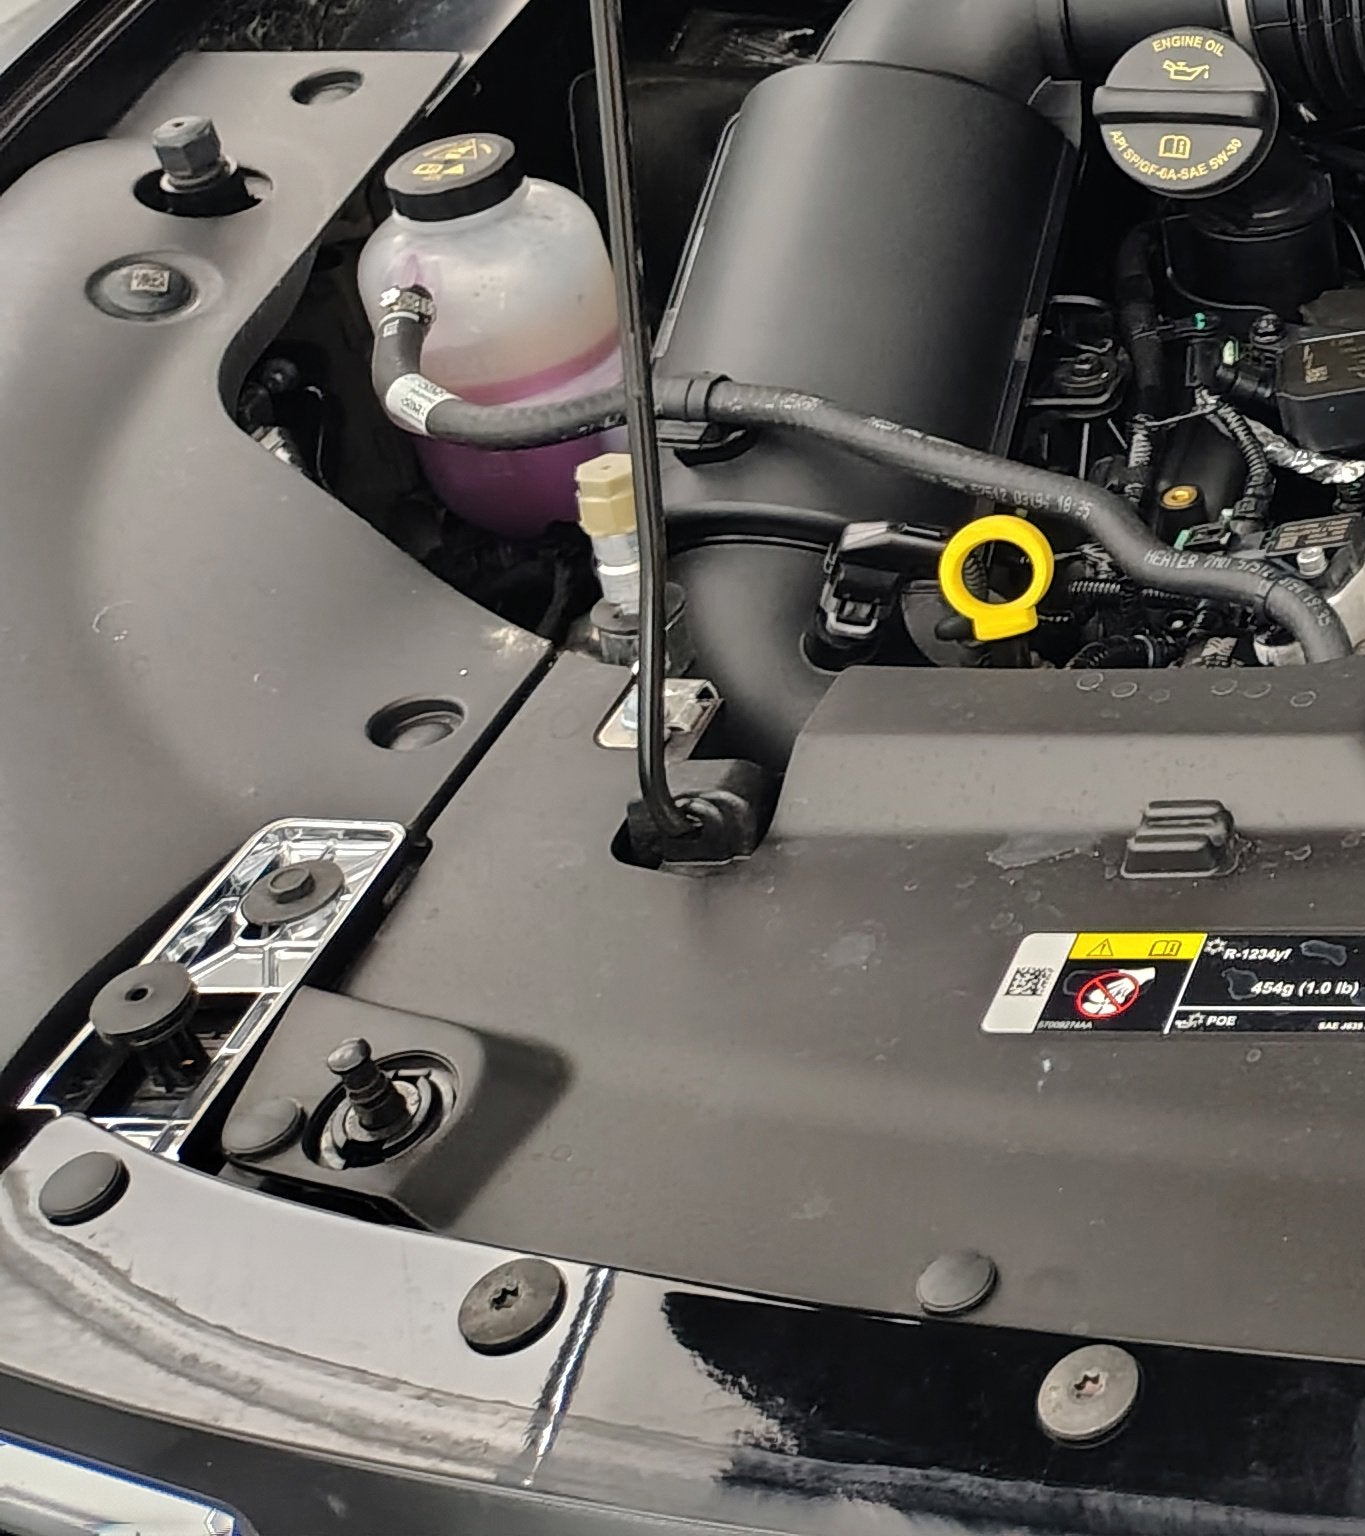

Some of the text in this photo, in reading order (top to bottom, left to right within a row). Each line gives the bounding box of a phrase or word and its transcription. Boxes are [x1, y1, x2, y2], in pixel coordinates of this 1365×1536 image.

[1152, 35, 1225, 58] ENGINE OIL
[1109, 130, 1125, 152] API
[1144, 549, 1199, 569] HEATER
[1223, 947, 1293, 963] R-1234yf
[1250, 981, 1360, 997] 454g (1.0 lb)
[1206, 1015, 1238, 1027] POE
